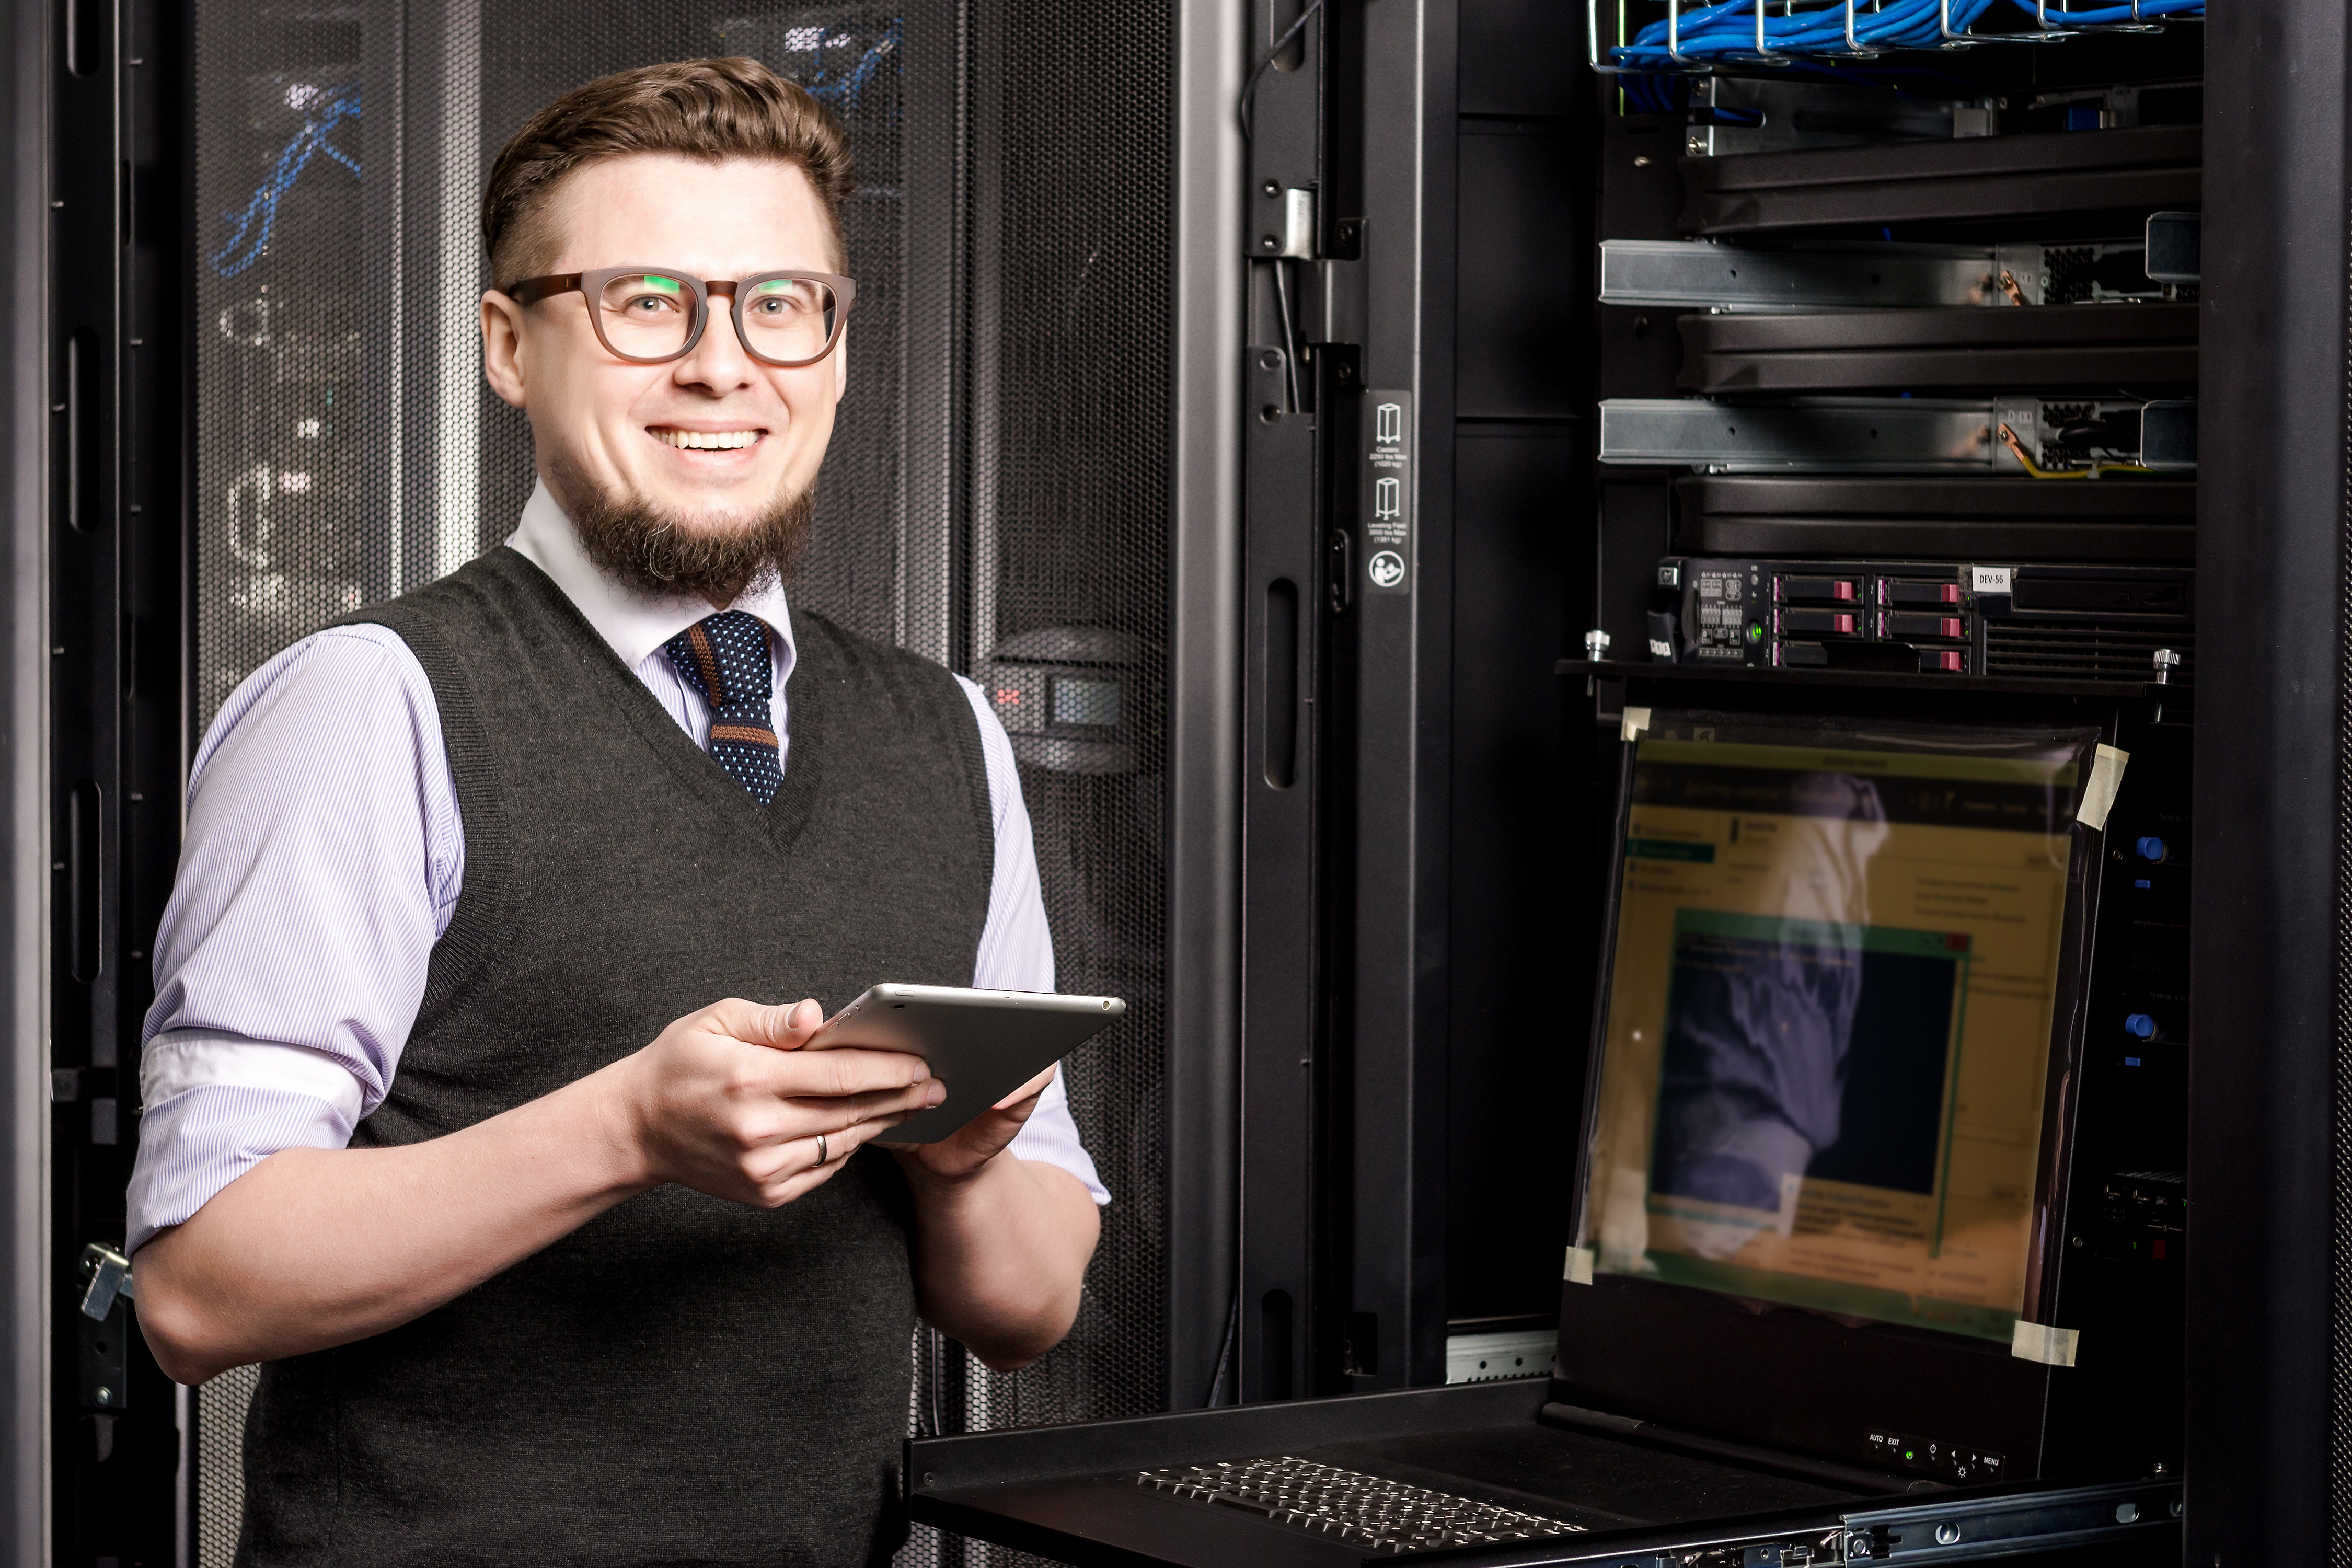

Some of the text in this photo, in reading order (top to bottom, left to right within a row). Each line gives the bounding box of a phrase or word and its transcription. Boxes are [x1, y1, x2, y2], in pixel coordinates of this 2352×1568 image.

[1979, 575, 2003, 584] DEV-56
[1870, 1434, 1883, 1443] AUTO
[1888, 1438, 1900, 1446] EXIT
[1984, 1457, 1999, 1466] MENU
